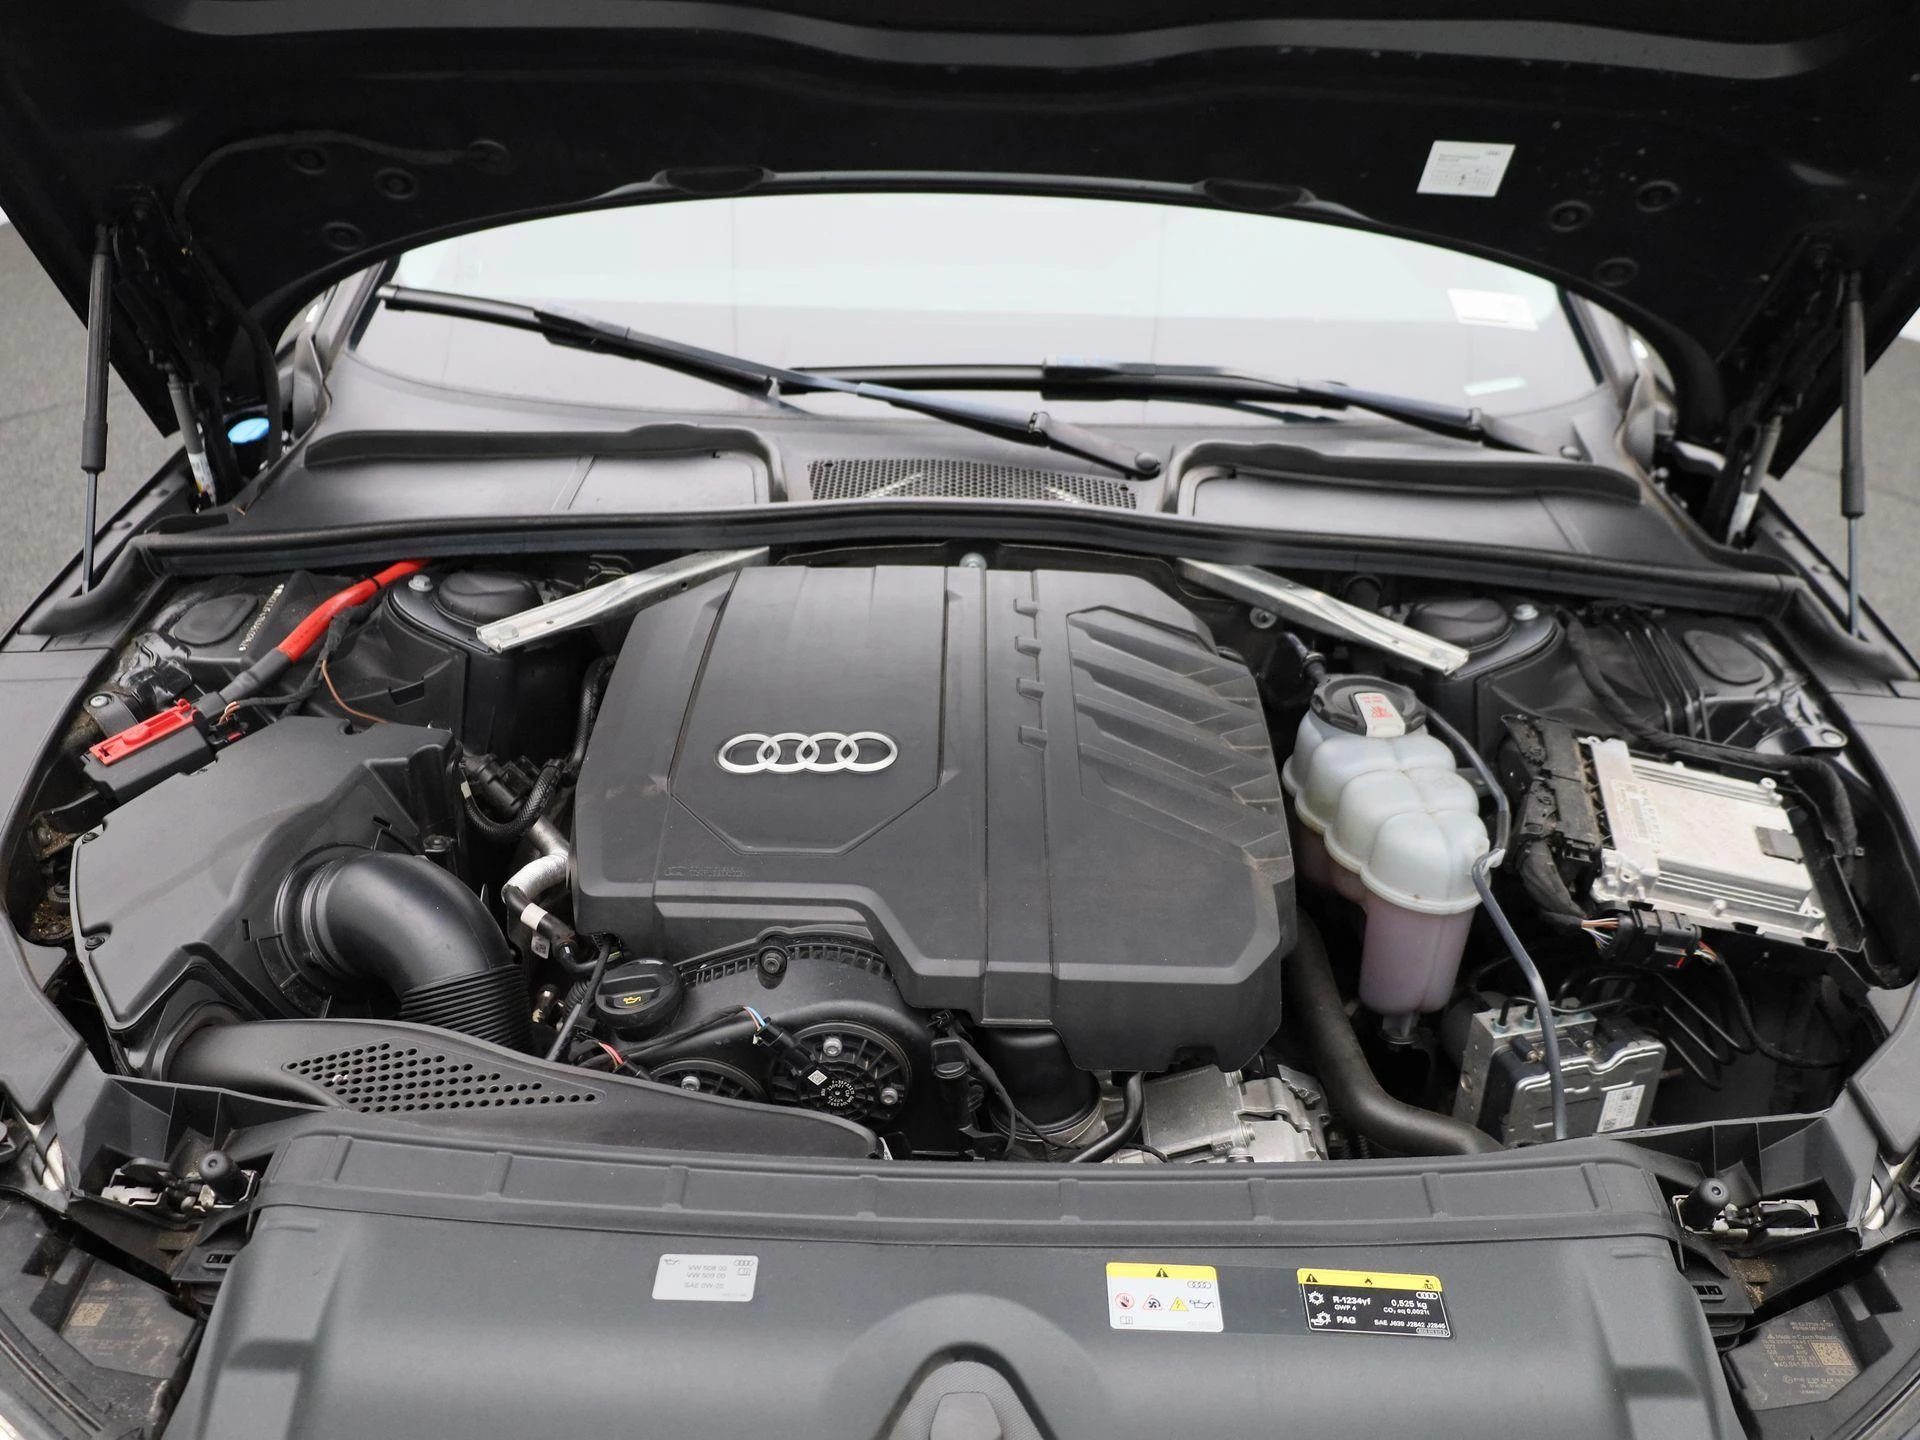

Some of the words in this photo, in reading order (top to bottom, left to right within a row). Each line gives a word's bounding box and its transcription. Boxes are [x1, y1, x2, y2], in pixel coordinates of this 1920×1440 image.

[1332, 1295, 1371, 1306] R-1234yf
[1390, 1299, 1415, 1308] 0,525
[1416, 1301, 1428, 1310] kg
[1336, 1315, 1357, 1324] PAG
